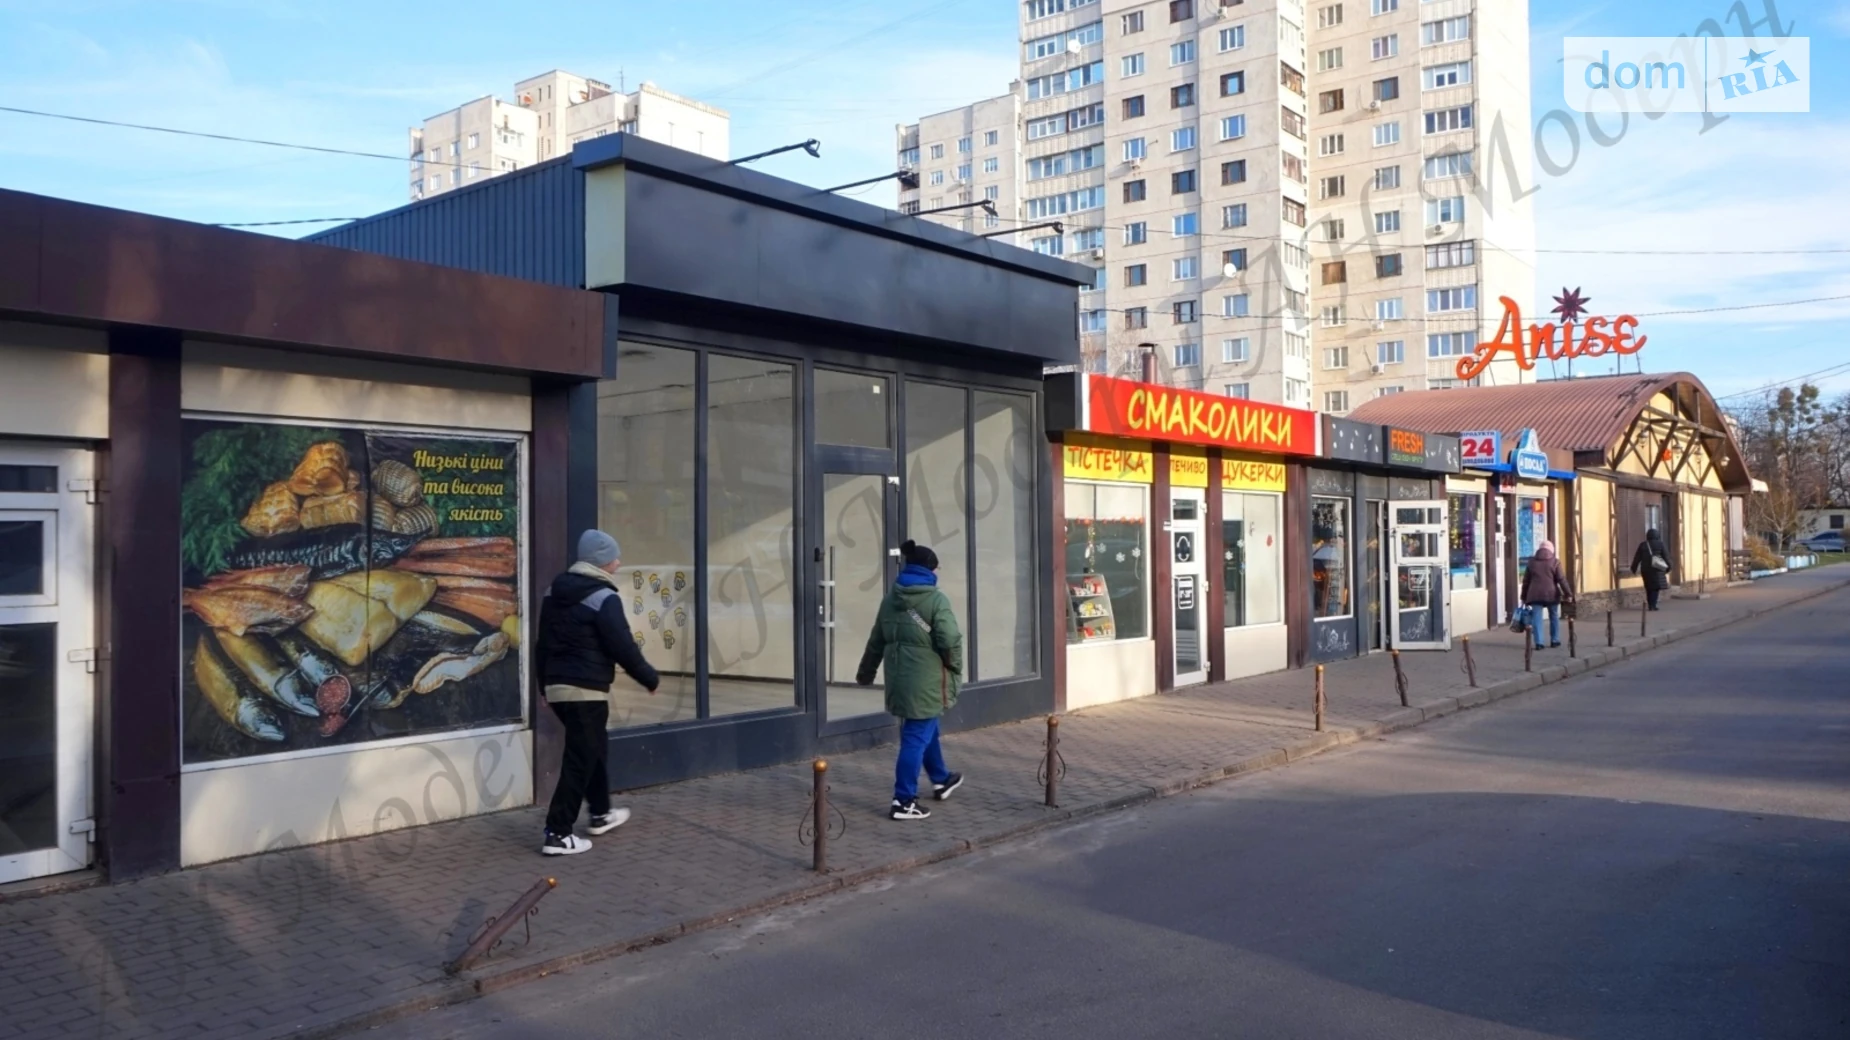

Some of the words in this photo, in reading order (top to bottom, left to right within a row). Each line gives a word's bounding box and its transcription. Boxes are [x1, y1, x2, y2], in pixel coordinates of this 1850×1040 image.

[1456, 295, 1647, 380] Anise
[1127, 388, 1292, 447] СМАКОЛИКИ
[1391, 429, 1424, 456] FRESH
[1462, 438, 1495, 457] 24
[413, 449, 468, 474] Низькі
[470, 454, 504, 474] ціни
[1068, 446, 1147, 475] ТІСТЕЧКА
[1221, 462, 1283, 484] ЦУКЕРКИ
[423, 481, 448, 494] та
[451, 478, 504, 496] висока
[449, 505, 504, 521] якість
